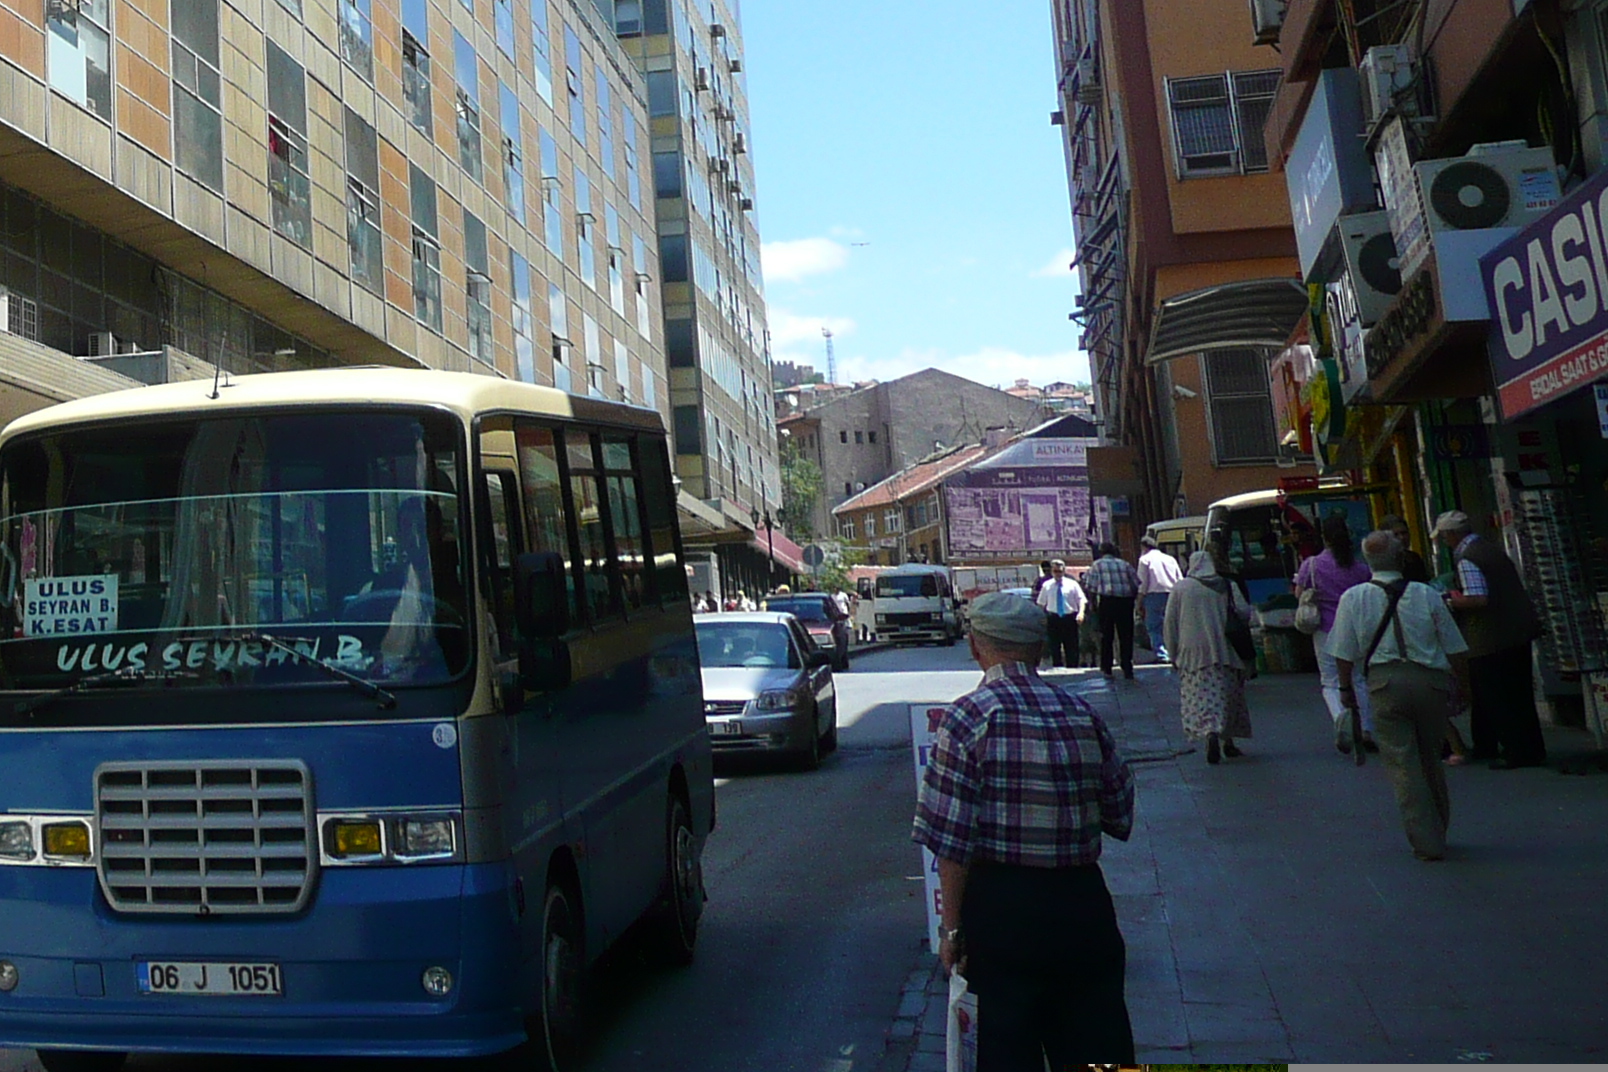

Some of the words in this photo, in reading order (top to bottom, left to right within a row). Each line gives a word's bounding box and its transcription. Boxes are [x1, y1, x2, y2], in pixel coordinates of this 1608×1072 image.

[1493, 186, 1608, 360] CASI
[1560, 352, 1588, 385] SAAT
[38, 580, 105, 597] ULUS
[27, 598, 91, 616] SEYRAN
[99, 598, 115, 614] B.
[31, 616, 109, 634] K.ESAT
[56, 643, 149, 672] ULUS
[150, 965, 180, 990] 06
[194, 965, 208, 990] J
[229, 966, 278, 992] 1051
